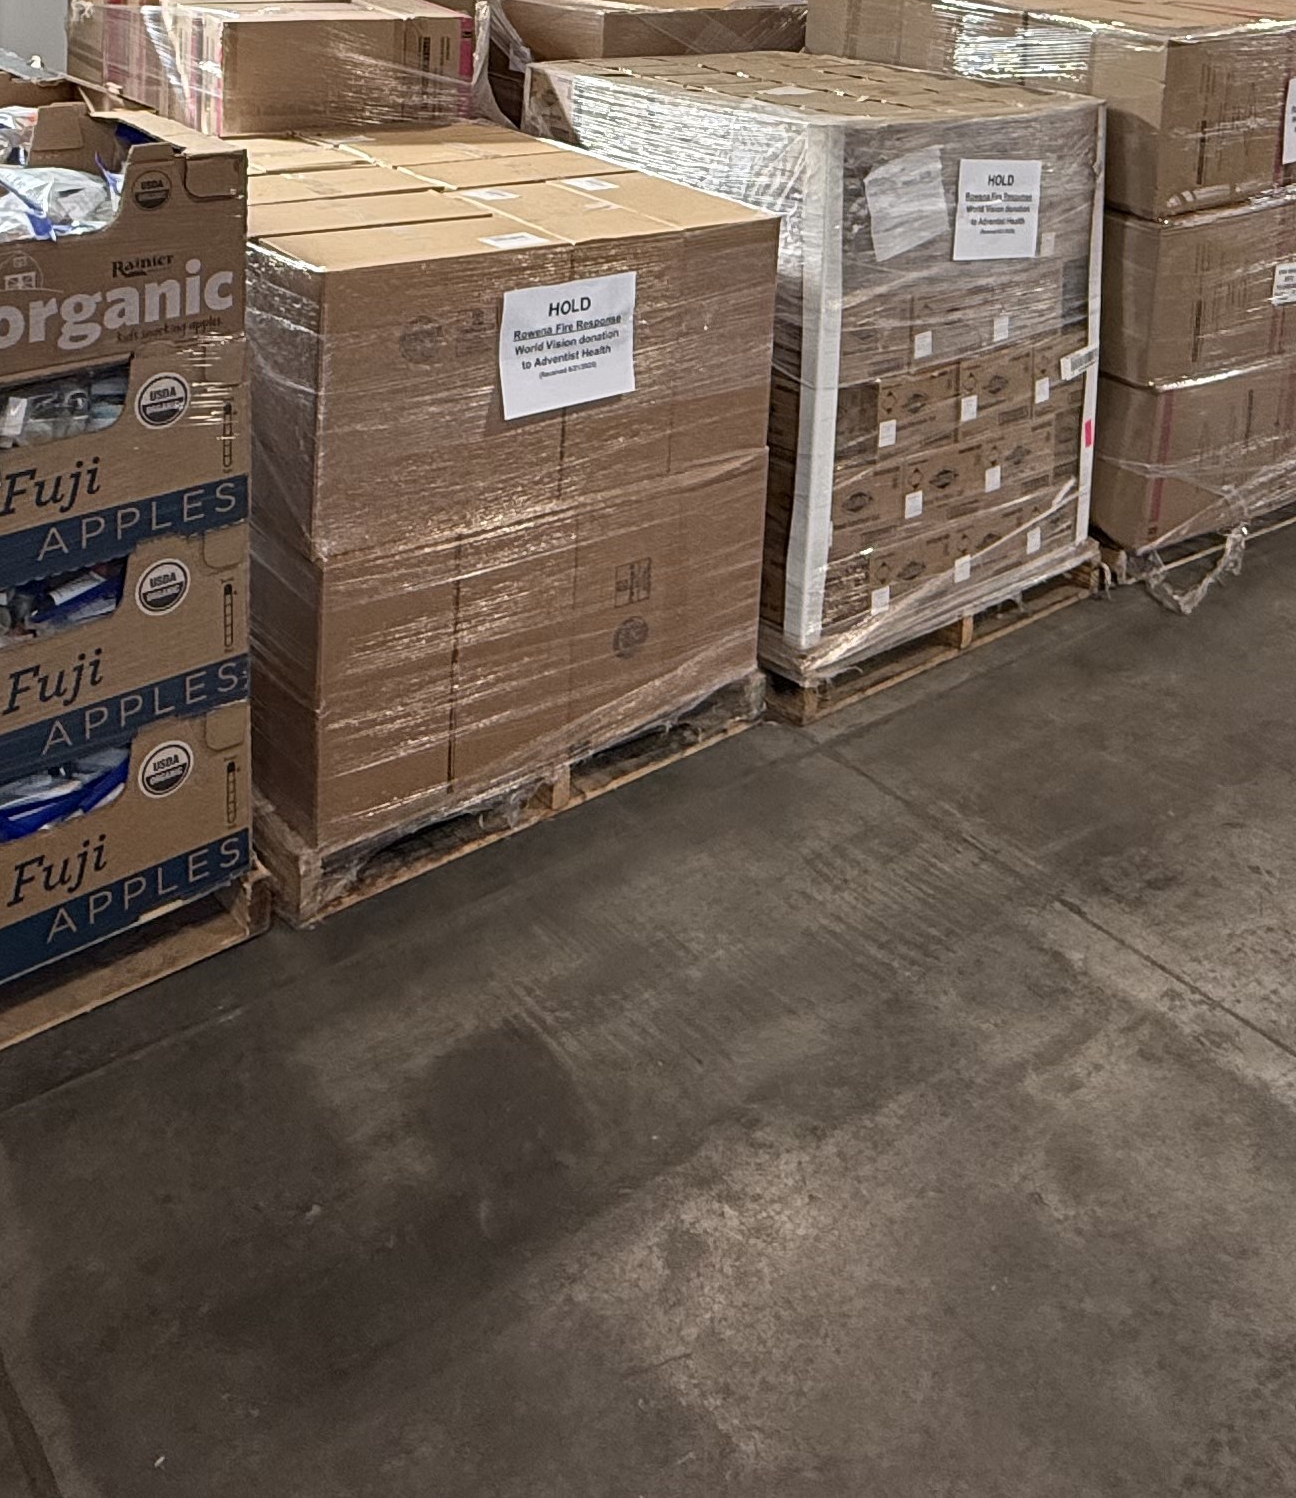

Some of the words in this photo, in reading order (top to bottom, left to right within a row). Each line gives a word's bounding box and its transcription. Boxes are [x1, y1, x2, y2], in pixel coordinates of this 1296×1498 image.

[140, 179, 164, 191] USDA
[988, 174, 1014, 186] HOLD
[111, 254, 175, 278] Rainier
[548, 297, 591, 317] HOLD
[513, 327, 552, 341] Rowena
[556, 323, 573, 333] Fire
[576, 315, 621, 330] Response
[515, 341, 544, 356] World
[546, 334, 577, 349] Vision
[579, 329, 619, 345] donation
[522, 359, 532, 370] to
[534, 351, 580, 368] Adventist
[581, 345, 611, 359] Health
[149, 386, 176, 401] USDA
[0, 456, 102, 517] Fuji
[36, 482, 238, 562] APPLES
[149, 572, 177, 588] USDA
[3, 647, 104, 715] Fuji
[42, 660, 242, 757] APPLES
[153, 754, 180, 772] USDA
[6, 834, 108, 907] Fuji
[47, 835, 242, 944] APPLES
